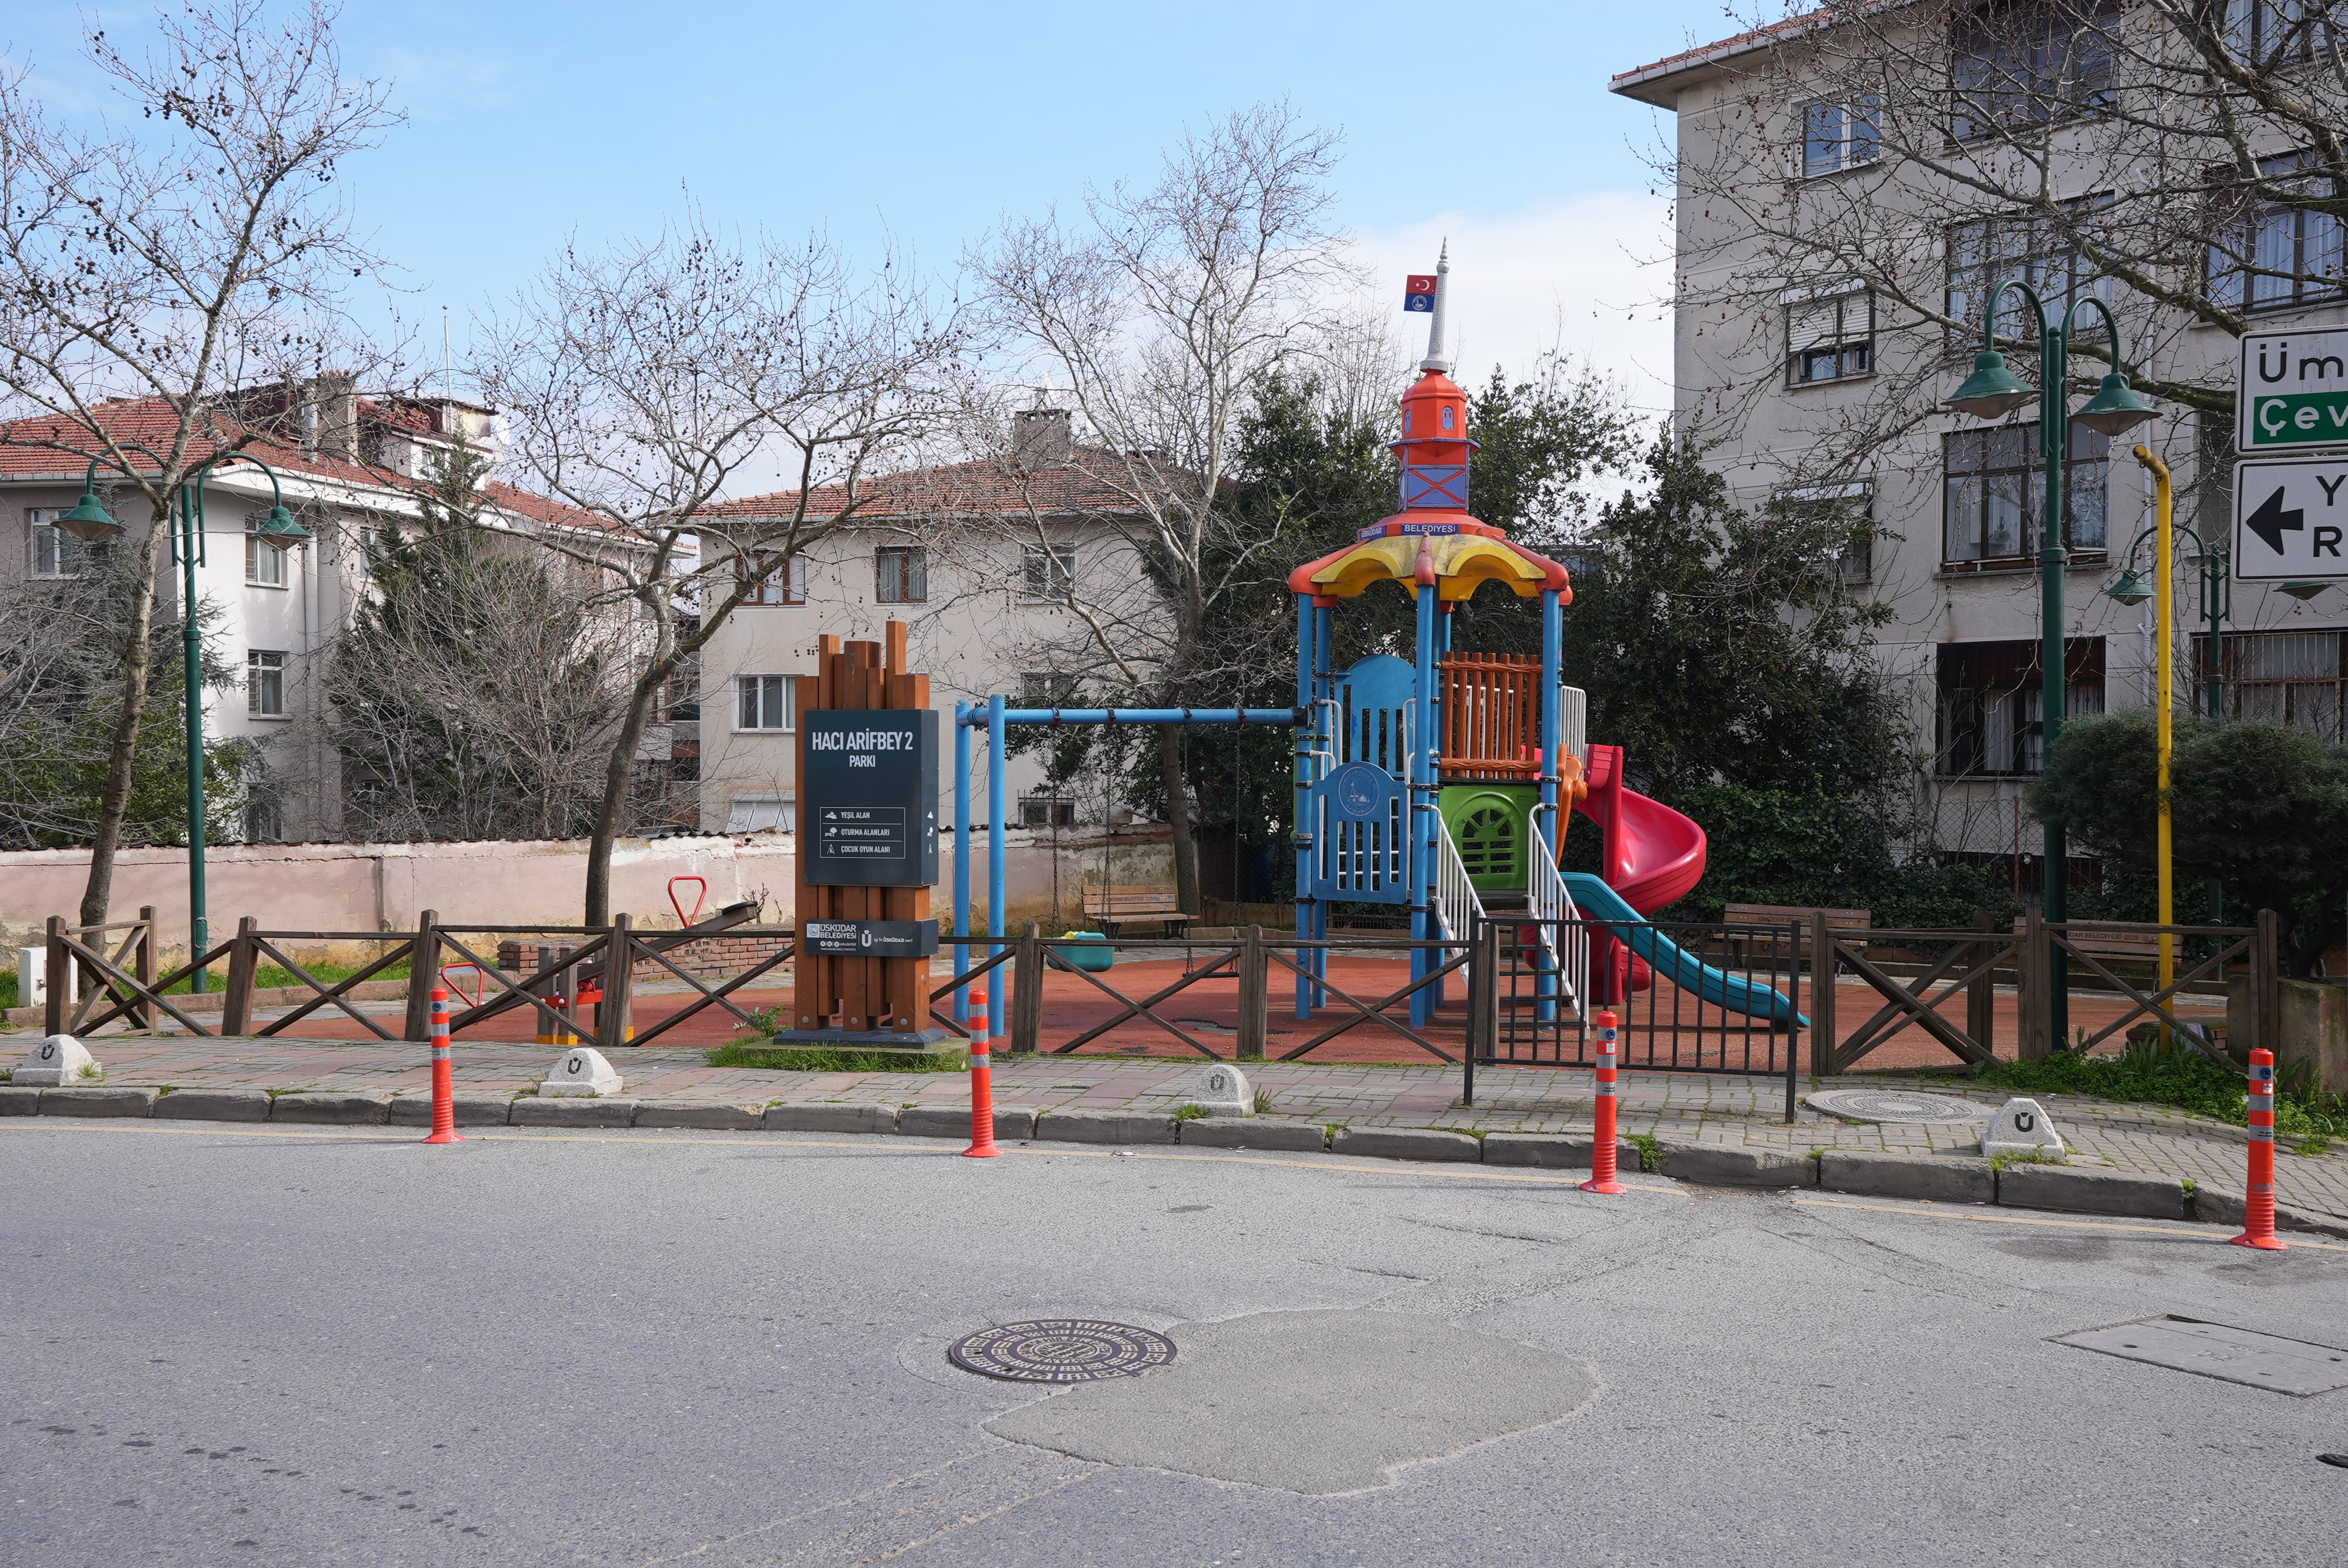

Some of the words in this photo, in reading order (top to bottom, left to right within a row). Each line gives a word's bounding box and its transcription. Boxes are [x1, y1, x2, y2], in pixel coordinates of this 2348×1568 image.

[2259, 342, 2344, 383] Üm
[2260, 399, 2348, 437] Çev
[2315, 474, 2348, 506] Y
[1361, 527, 1382, 538] ÜSKÜDAR
[2313, 526, 2342, 558] R
[812, 732, 843, 750] HACI
[846, 728, 903, 750] ARİFBEY
[904, 731, 913, 750] 2
[849, 755, 876, 767] PARKI
[841, 845, 859, 854] ÇOCUK
[820, 924, 857, 932] ÜSKÜDAR
